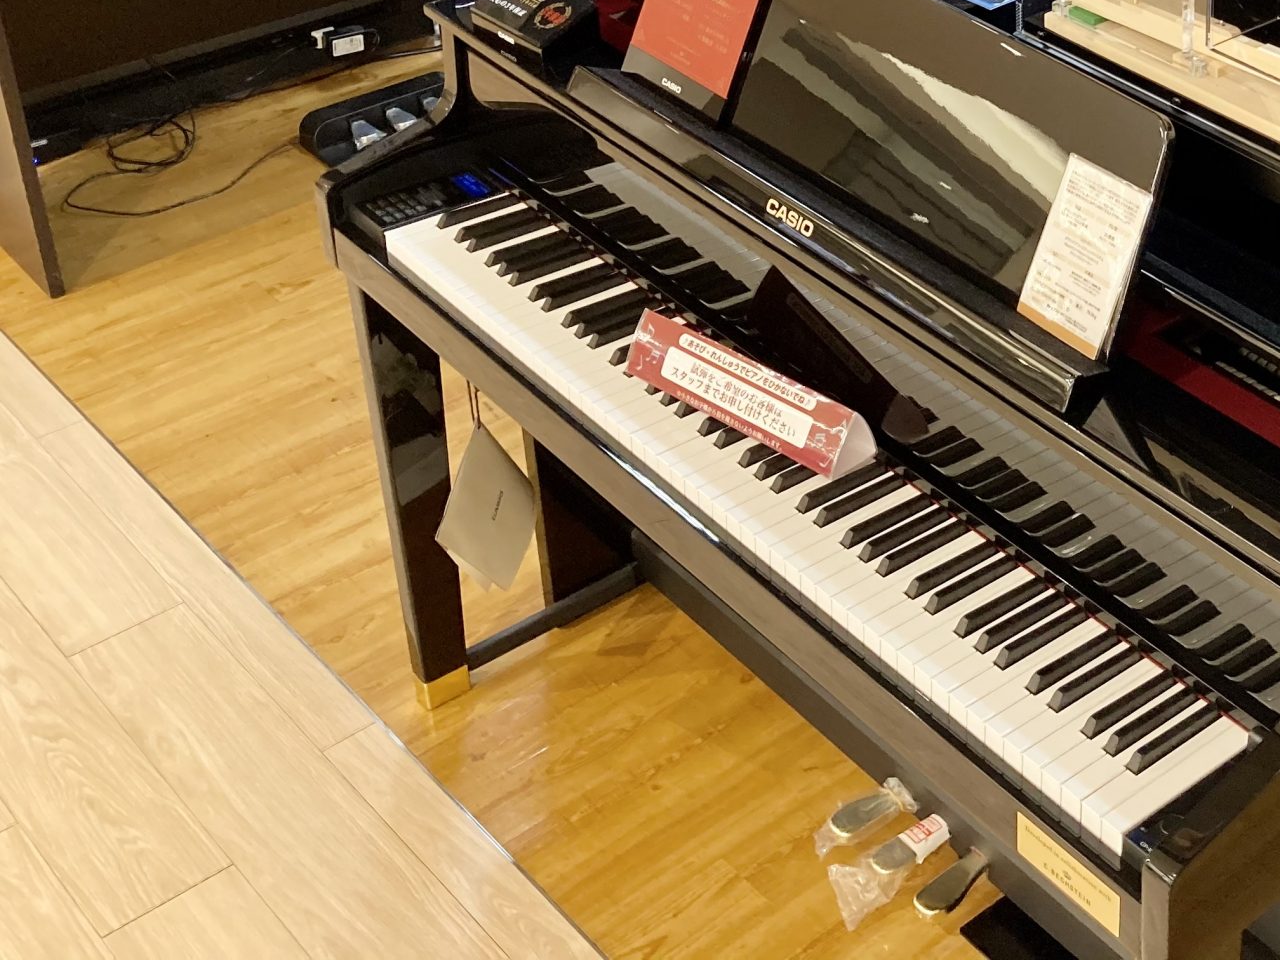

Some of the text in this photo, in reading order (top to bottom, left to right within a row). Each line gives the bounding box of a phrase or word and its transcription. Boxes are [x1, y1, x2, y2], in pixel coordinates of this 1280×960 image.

[661, 77, 682, 94] CASIO
[766, 198, 814, 238] CASIO
[671, 367, 797, 438] スタッフまでお申し付けください
[690, 361, 784, 418] 試弾をご希望のお客様は
[1051, 870, 1092, 907] BECHSTEIN
